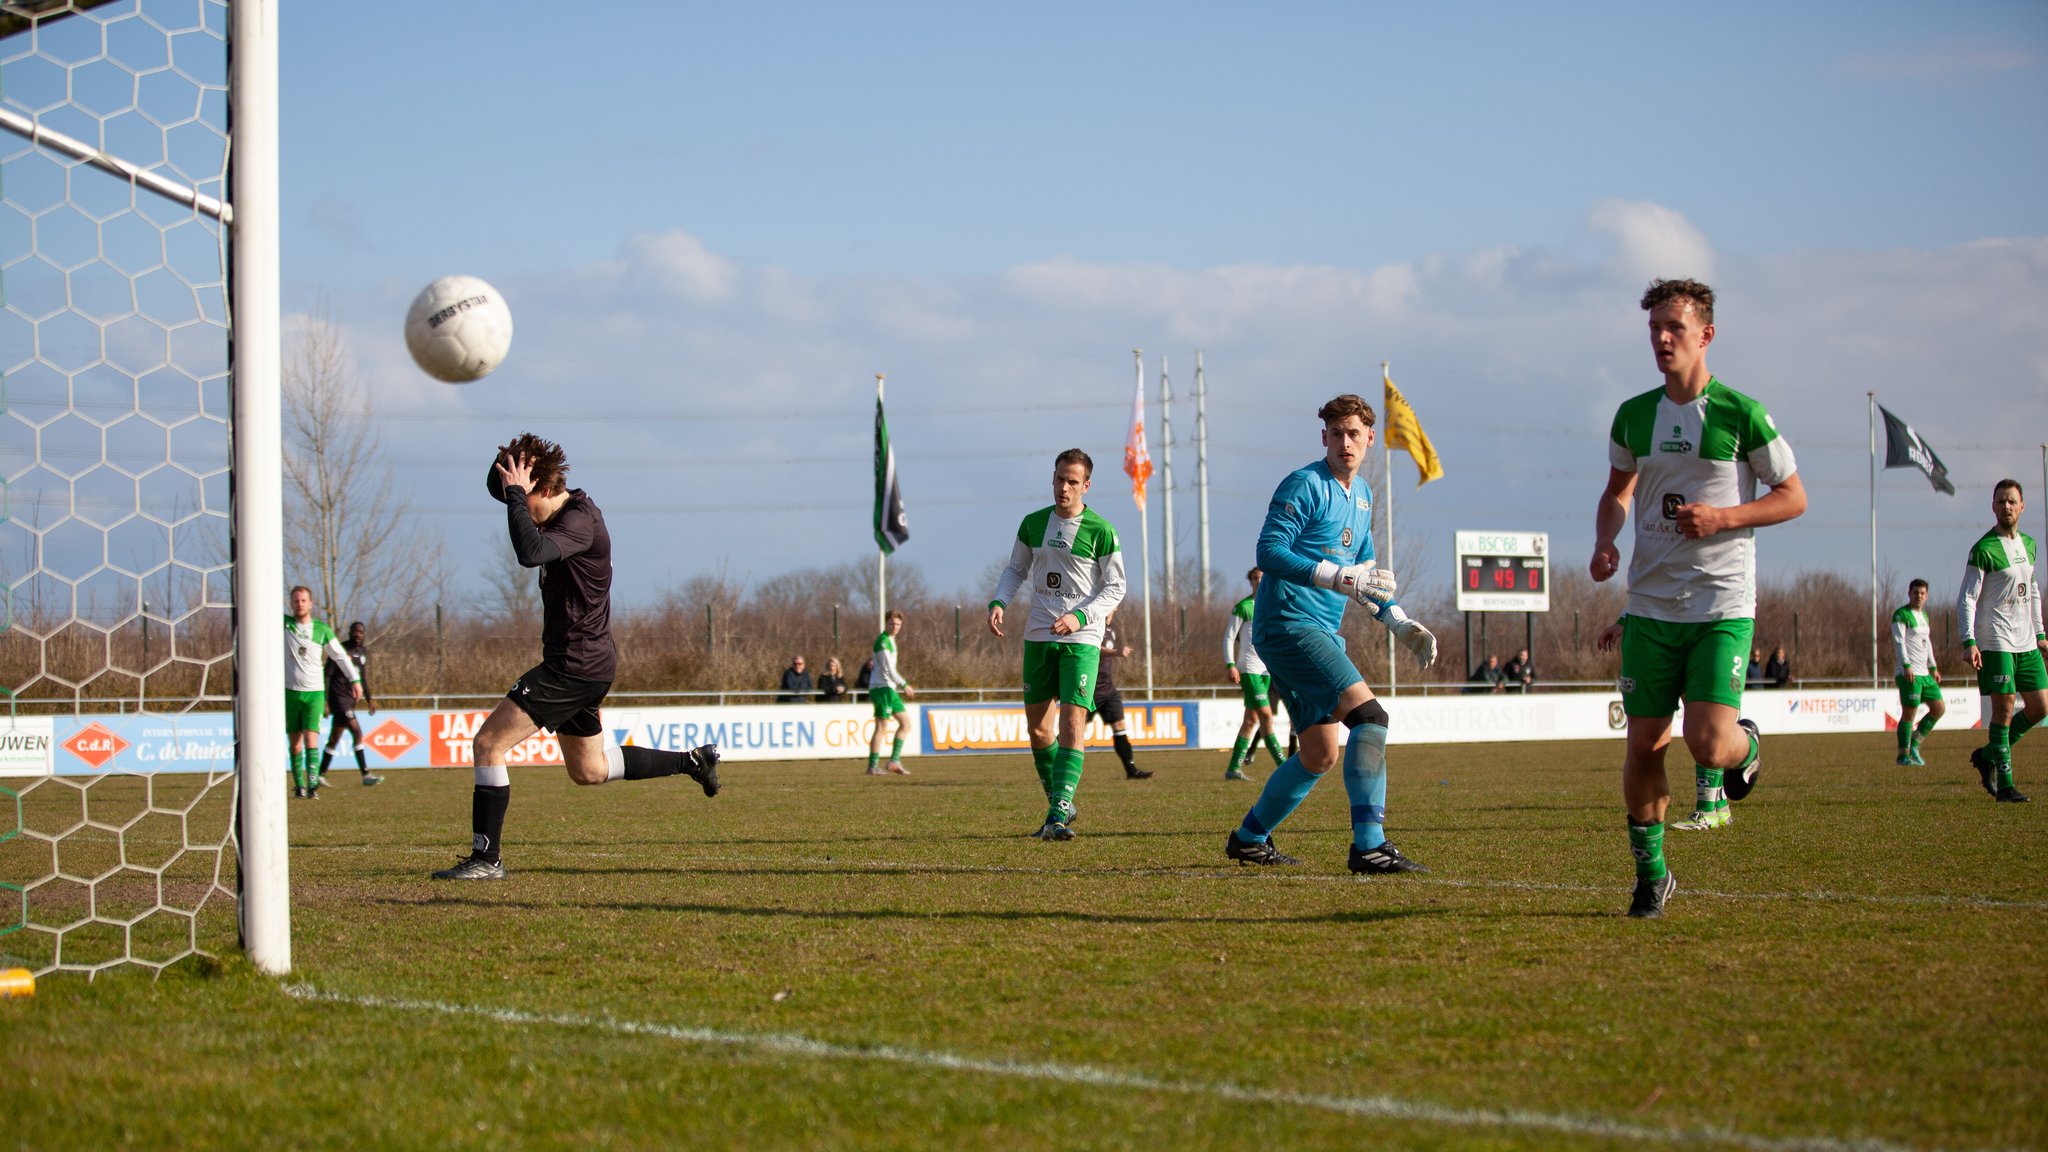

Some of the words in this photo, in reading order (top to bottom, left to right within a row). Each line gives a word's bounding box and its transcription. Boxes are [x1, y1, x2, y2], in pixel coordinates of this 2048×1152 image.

[1470, 569, 1479, 589] 0
[1494, 569, 1515, 589] 49
[1529, 570, 1538, 590] 0
[1732, 656, 1742, 676] 2
[1080, 674, 1088, 687] 3
[1801, 698, 1876, 713] INTERSPORT
[373, 734, 410, 746] C.d.R.
[646, 720, 815, 750] VERMEULEN
[824, 719, 896, 747] GROE
[136, 742, 155, 761] C.
